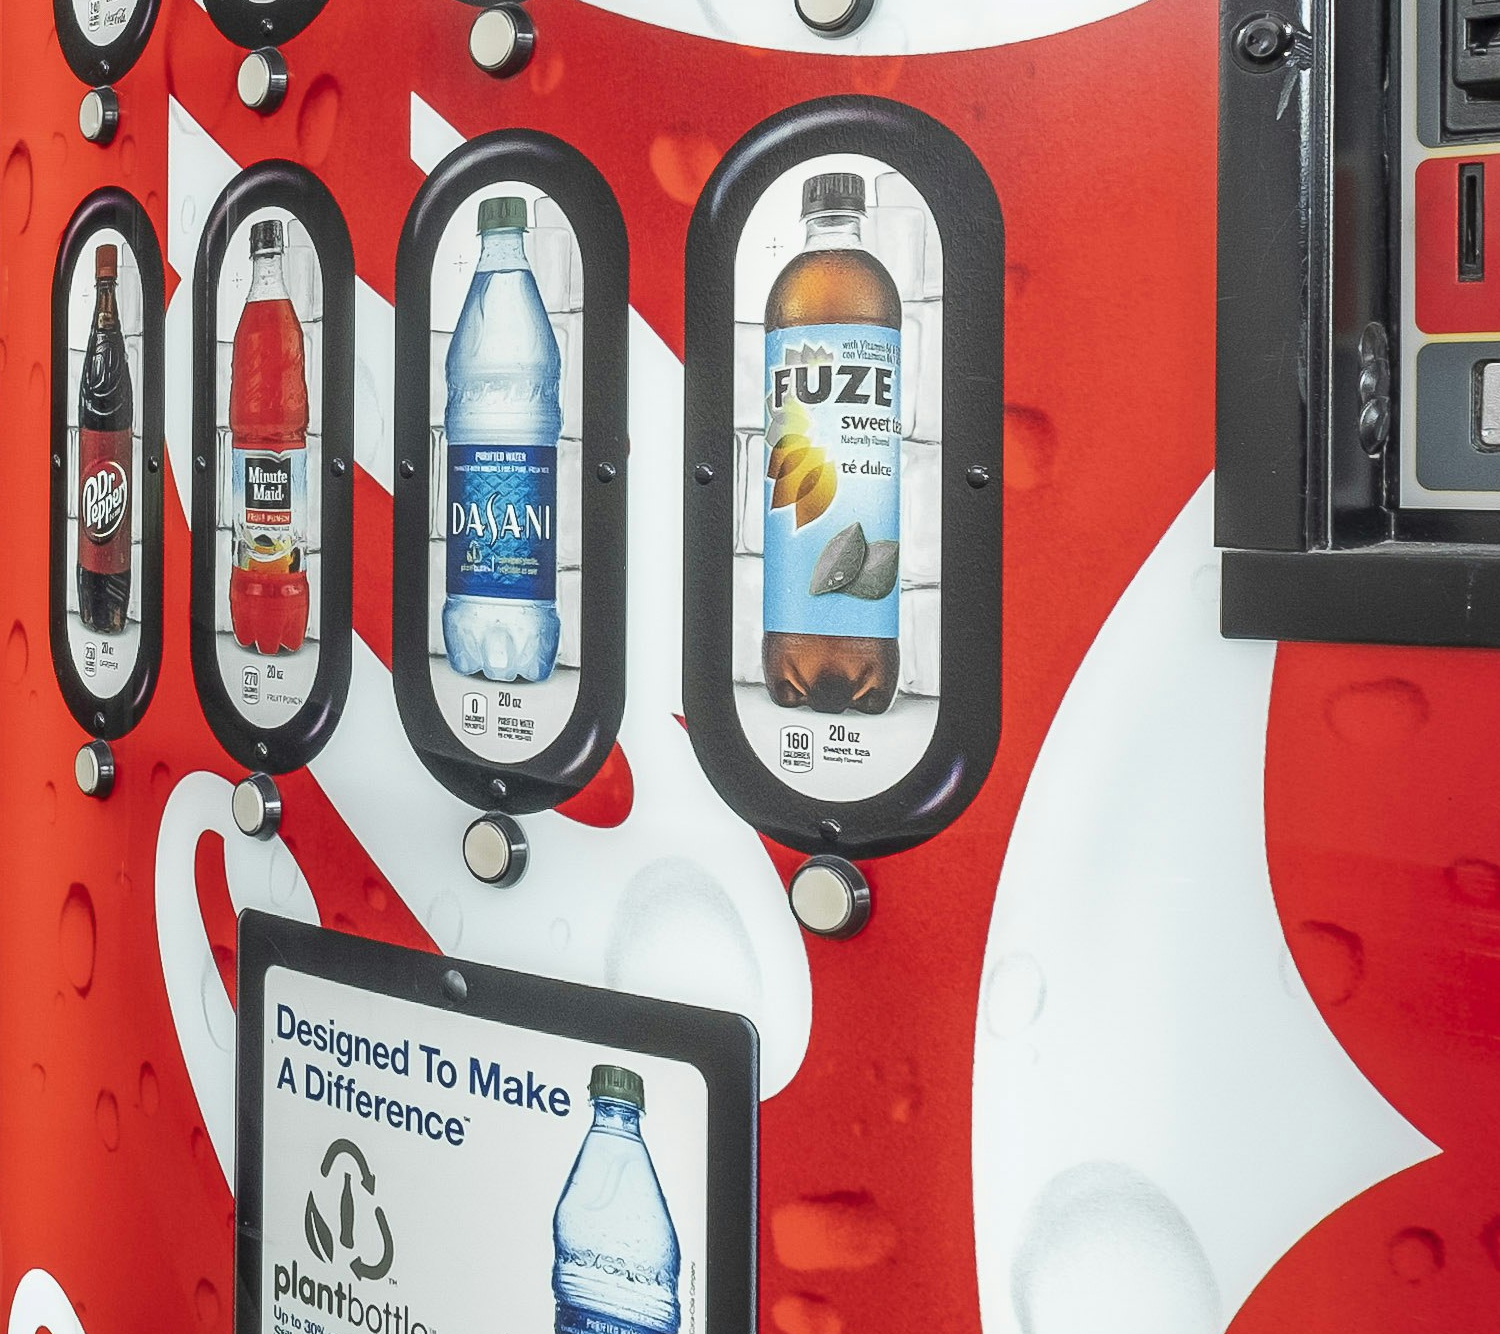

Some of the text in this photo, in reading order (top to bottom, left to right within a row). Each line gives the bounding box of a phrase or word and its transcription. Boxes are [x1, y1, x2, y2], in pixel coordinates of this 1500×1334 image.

[774, 365, 893, 408] FUZE
[840, 415, 891, 433] sweet
[840, 435, 871, 447] Naturally
[505, 451, 527, 463] WATER
[248, 466, 288, 484] Minute
[840, 459, 892, 477] té dulce
[96, 470, 116, 502] Dr
[253, 483, 283, 501] Maid
[83, 476, 126, 530] Pepper
[452, 491, 550, 546] DASANI
[471, 698, 479, 714] 0
[498, 691, 522, 709] 20 oz
[785, 731, 809, 750] 160
[829, 724, 861, 743] 20 oz
[276, 1003, 571, 1117] Designed To Make
[276, 1056, 297, 1095] A
[273, 1304, 289, 1326] Up
[291, 1312, 301, 1330] to
